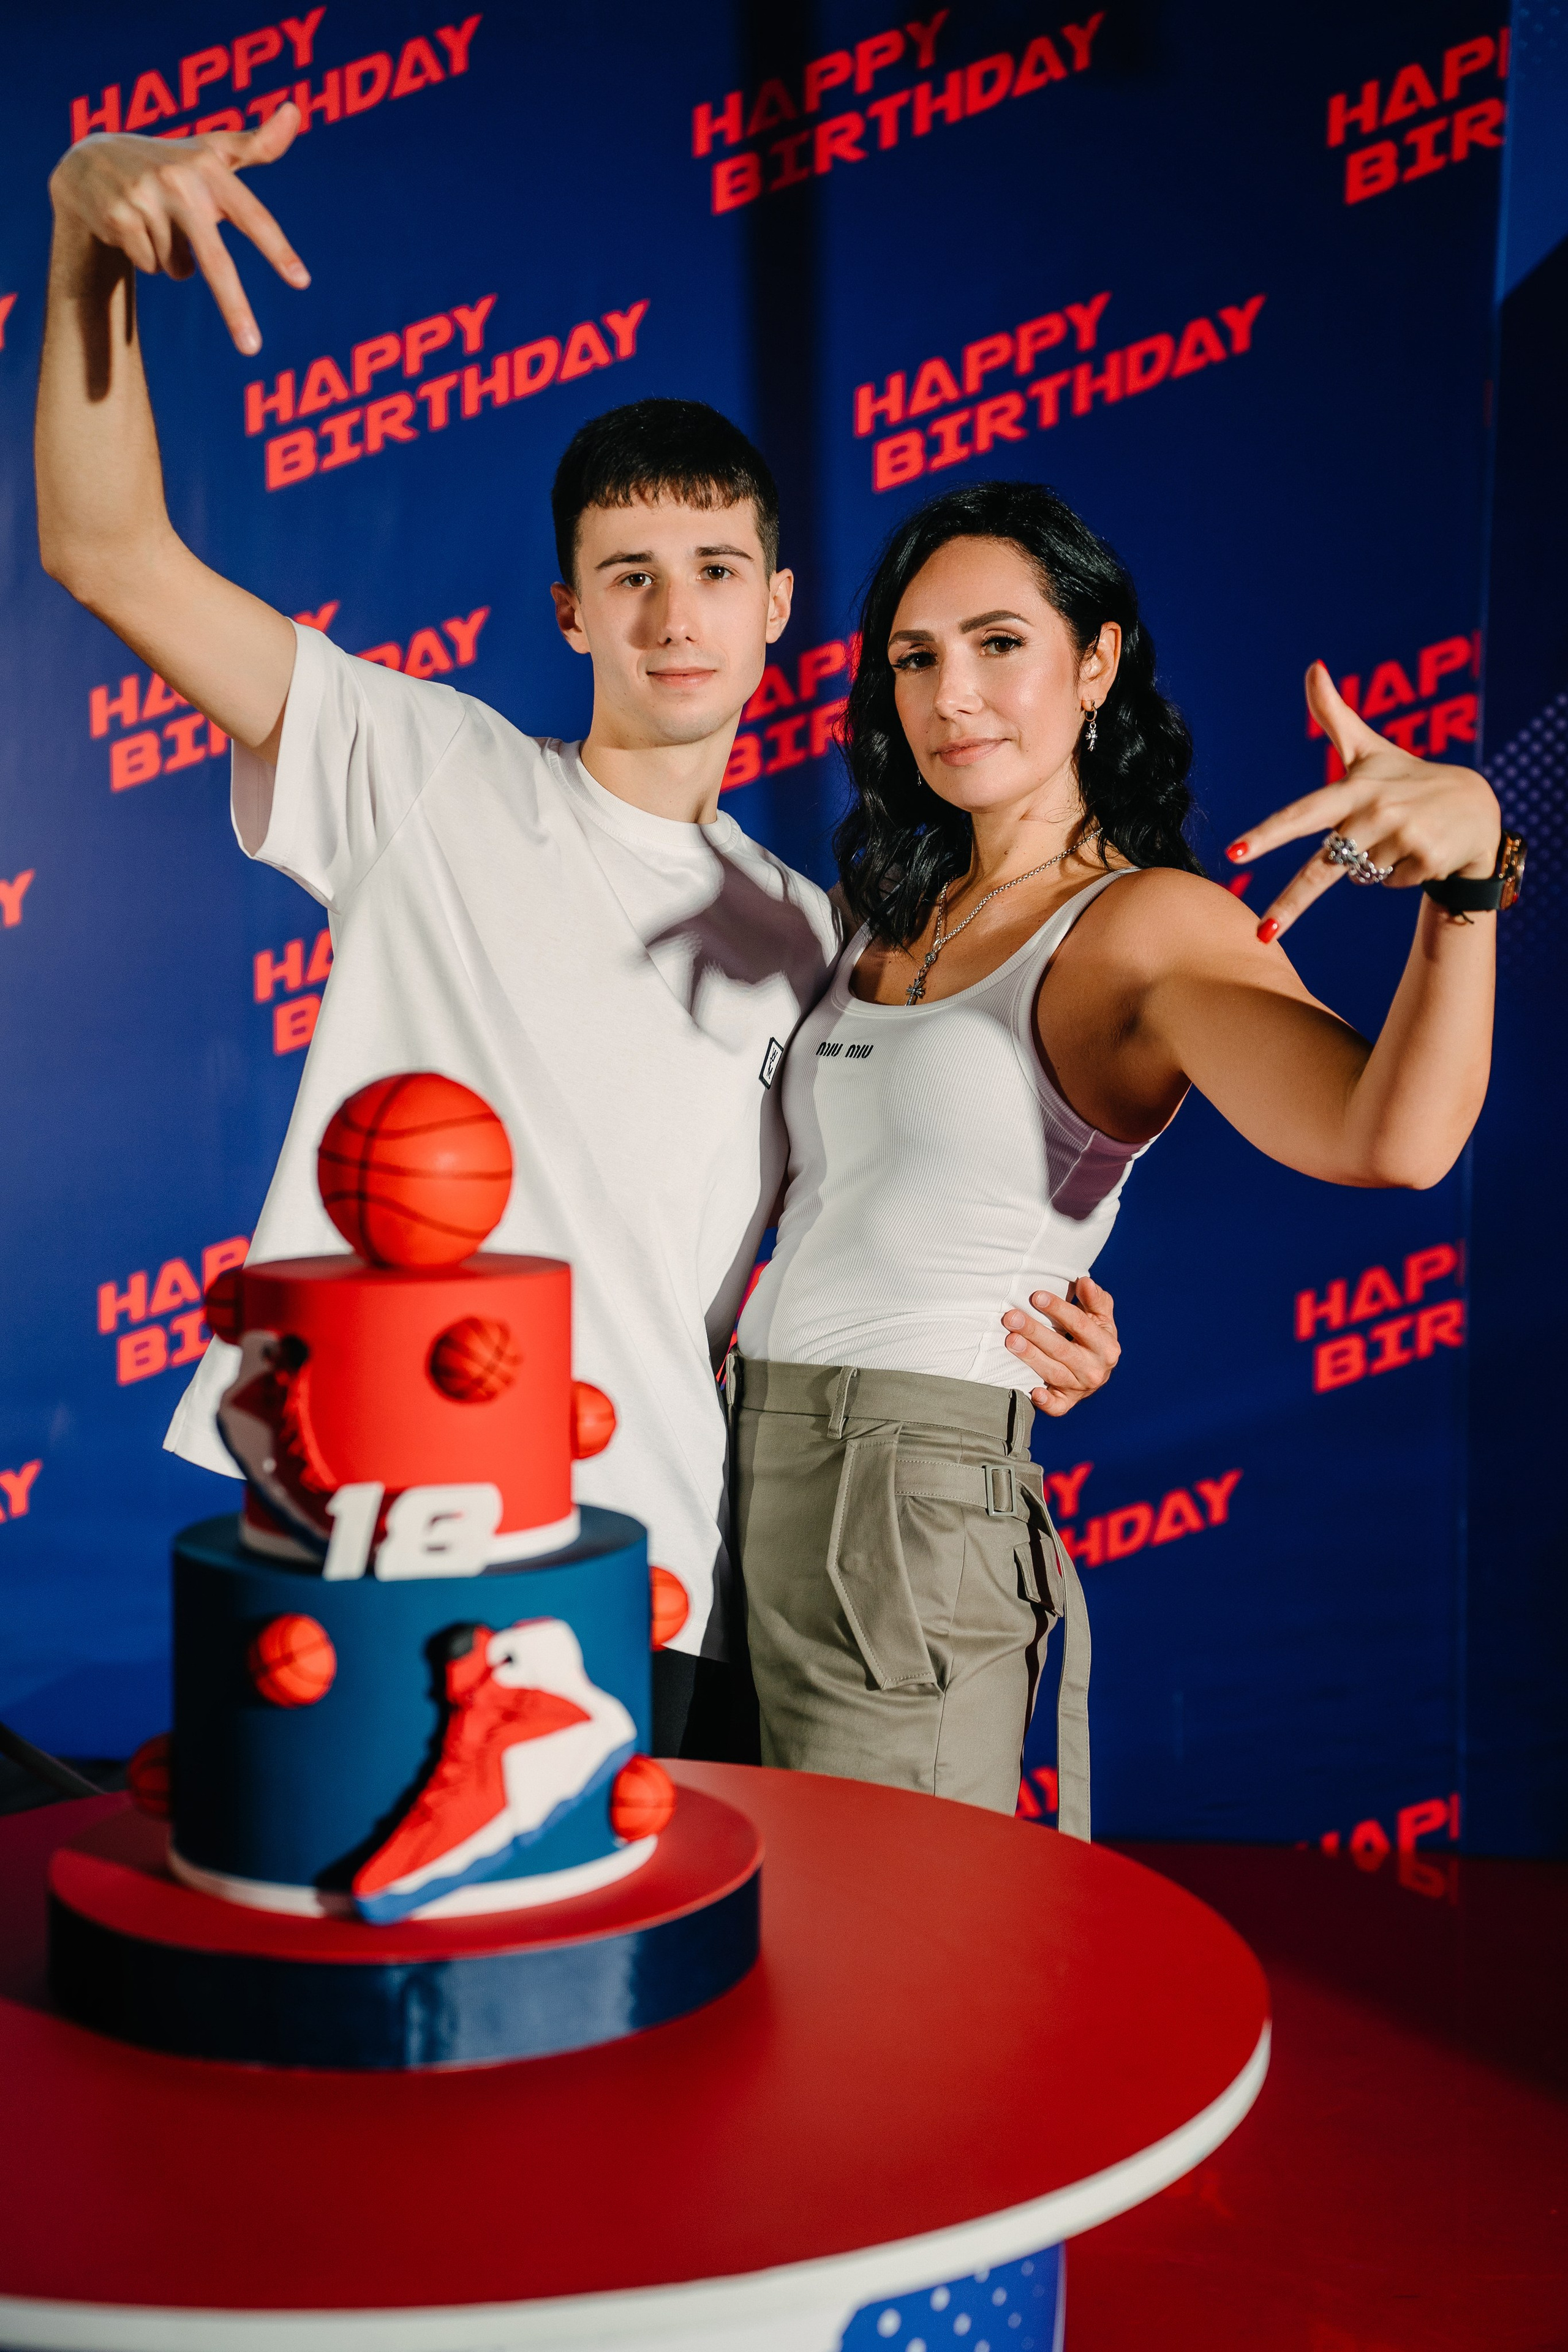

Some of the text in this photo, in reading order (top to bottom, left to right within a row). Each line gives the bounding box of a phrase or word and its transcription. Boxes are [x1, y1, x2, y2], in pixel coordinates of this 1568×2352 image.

[70, 5, 328, 147] HAPPY
[692, 7, 951, 159] HAPPY
[711, 10, 1105, 217] BIRTHDAY
[245, 293, 498, 436] HAPPY
[265, 299, 650, 491] BIRTHDAY
[853, 291, 1112, 438] HAPPY
[872, 292, 1268, 492] BIRTHDAY
[1294, 1238, 1466, 1342] HAP
[323, 1481, 504, 1583] 18
